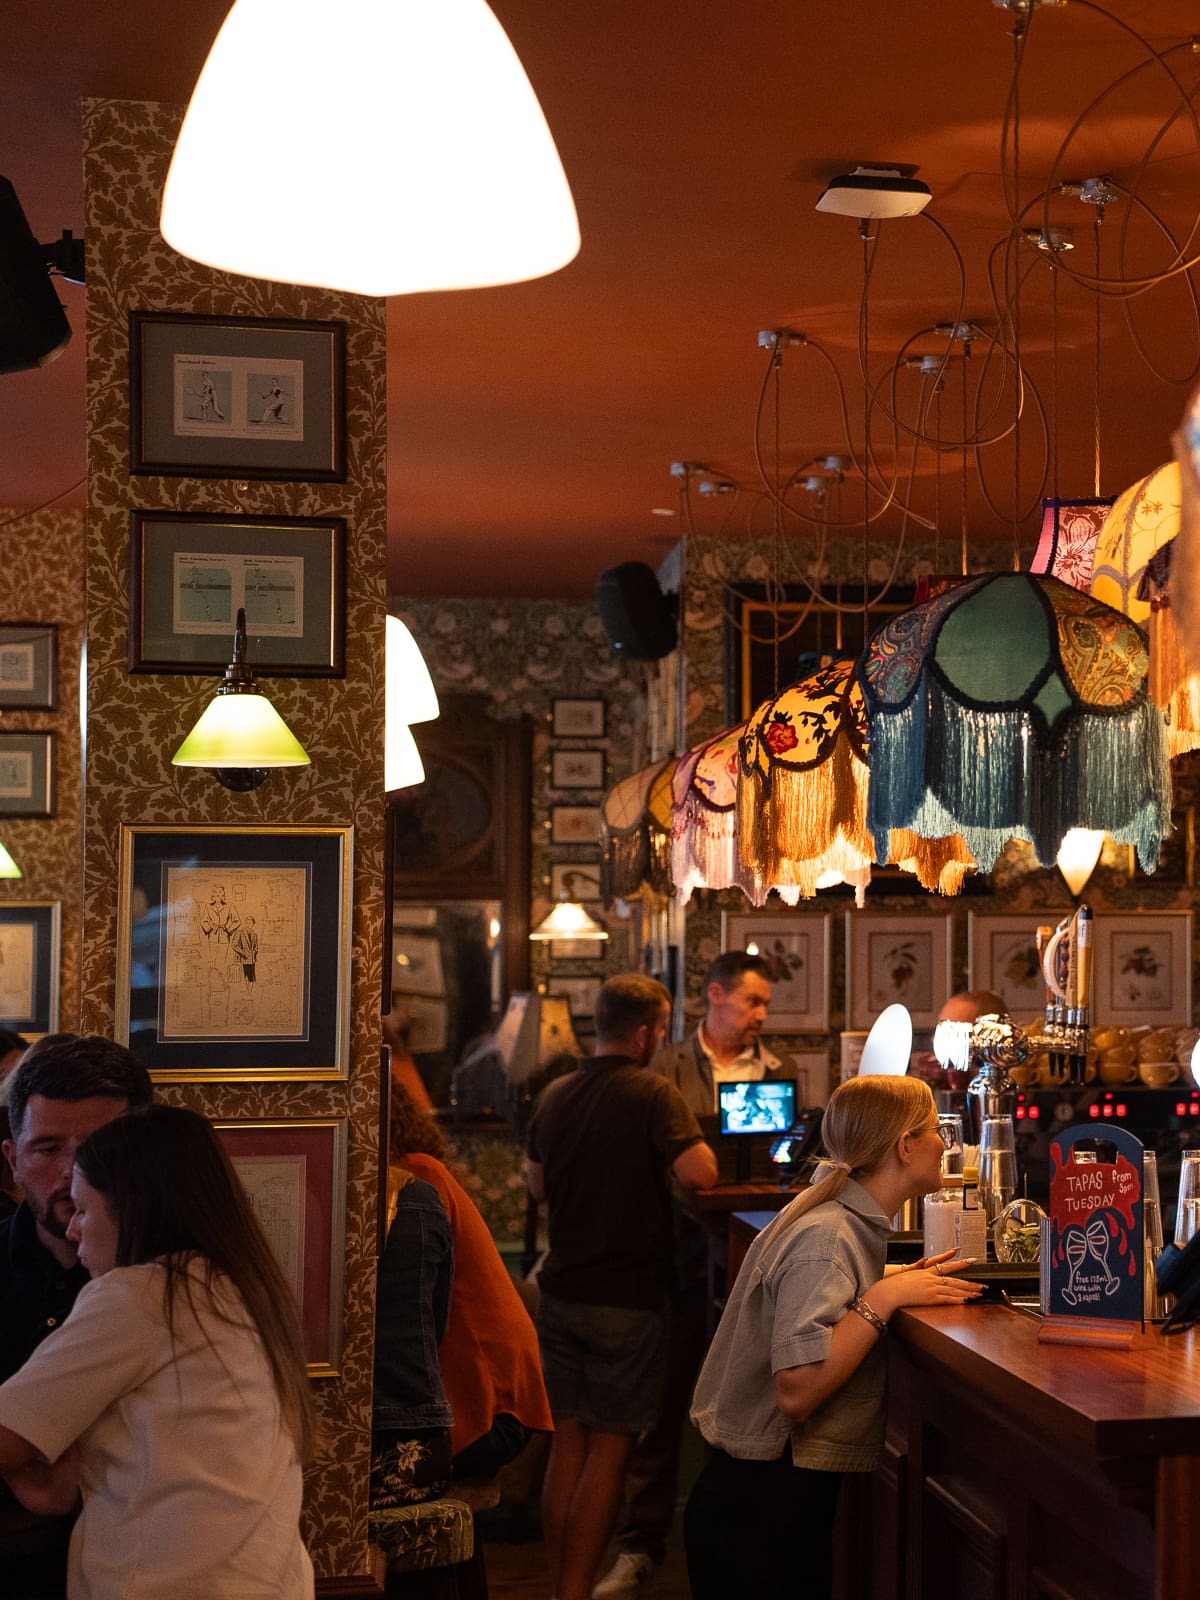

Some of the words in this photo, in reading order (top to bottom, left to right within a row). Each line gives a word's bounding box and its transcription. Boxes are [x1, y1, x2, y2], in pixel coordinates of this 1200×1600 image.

[1066, 1171, 1103, 1192] TAPAS
[1112, 1169, 1132, 1183] from
[1064, 1193, 1115, 1212] TUESDAY
[1075, 1271, 1089, 1283] free
